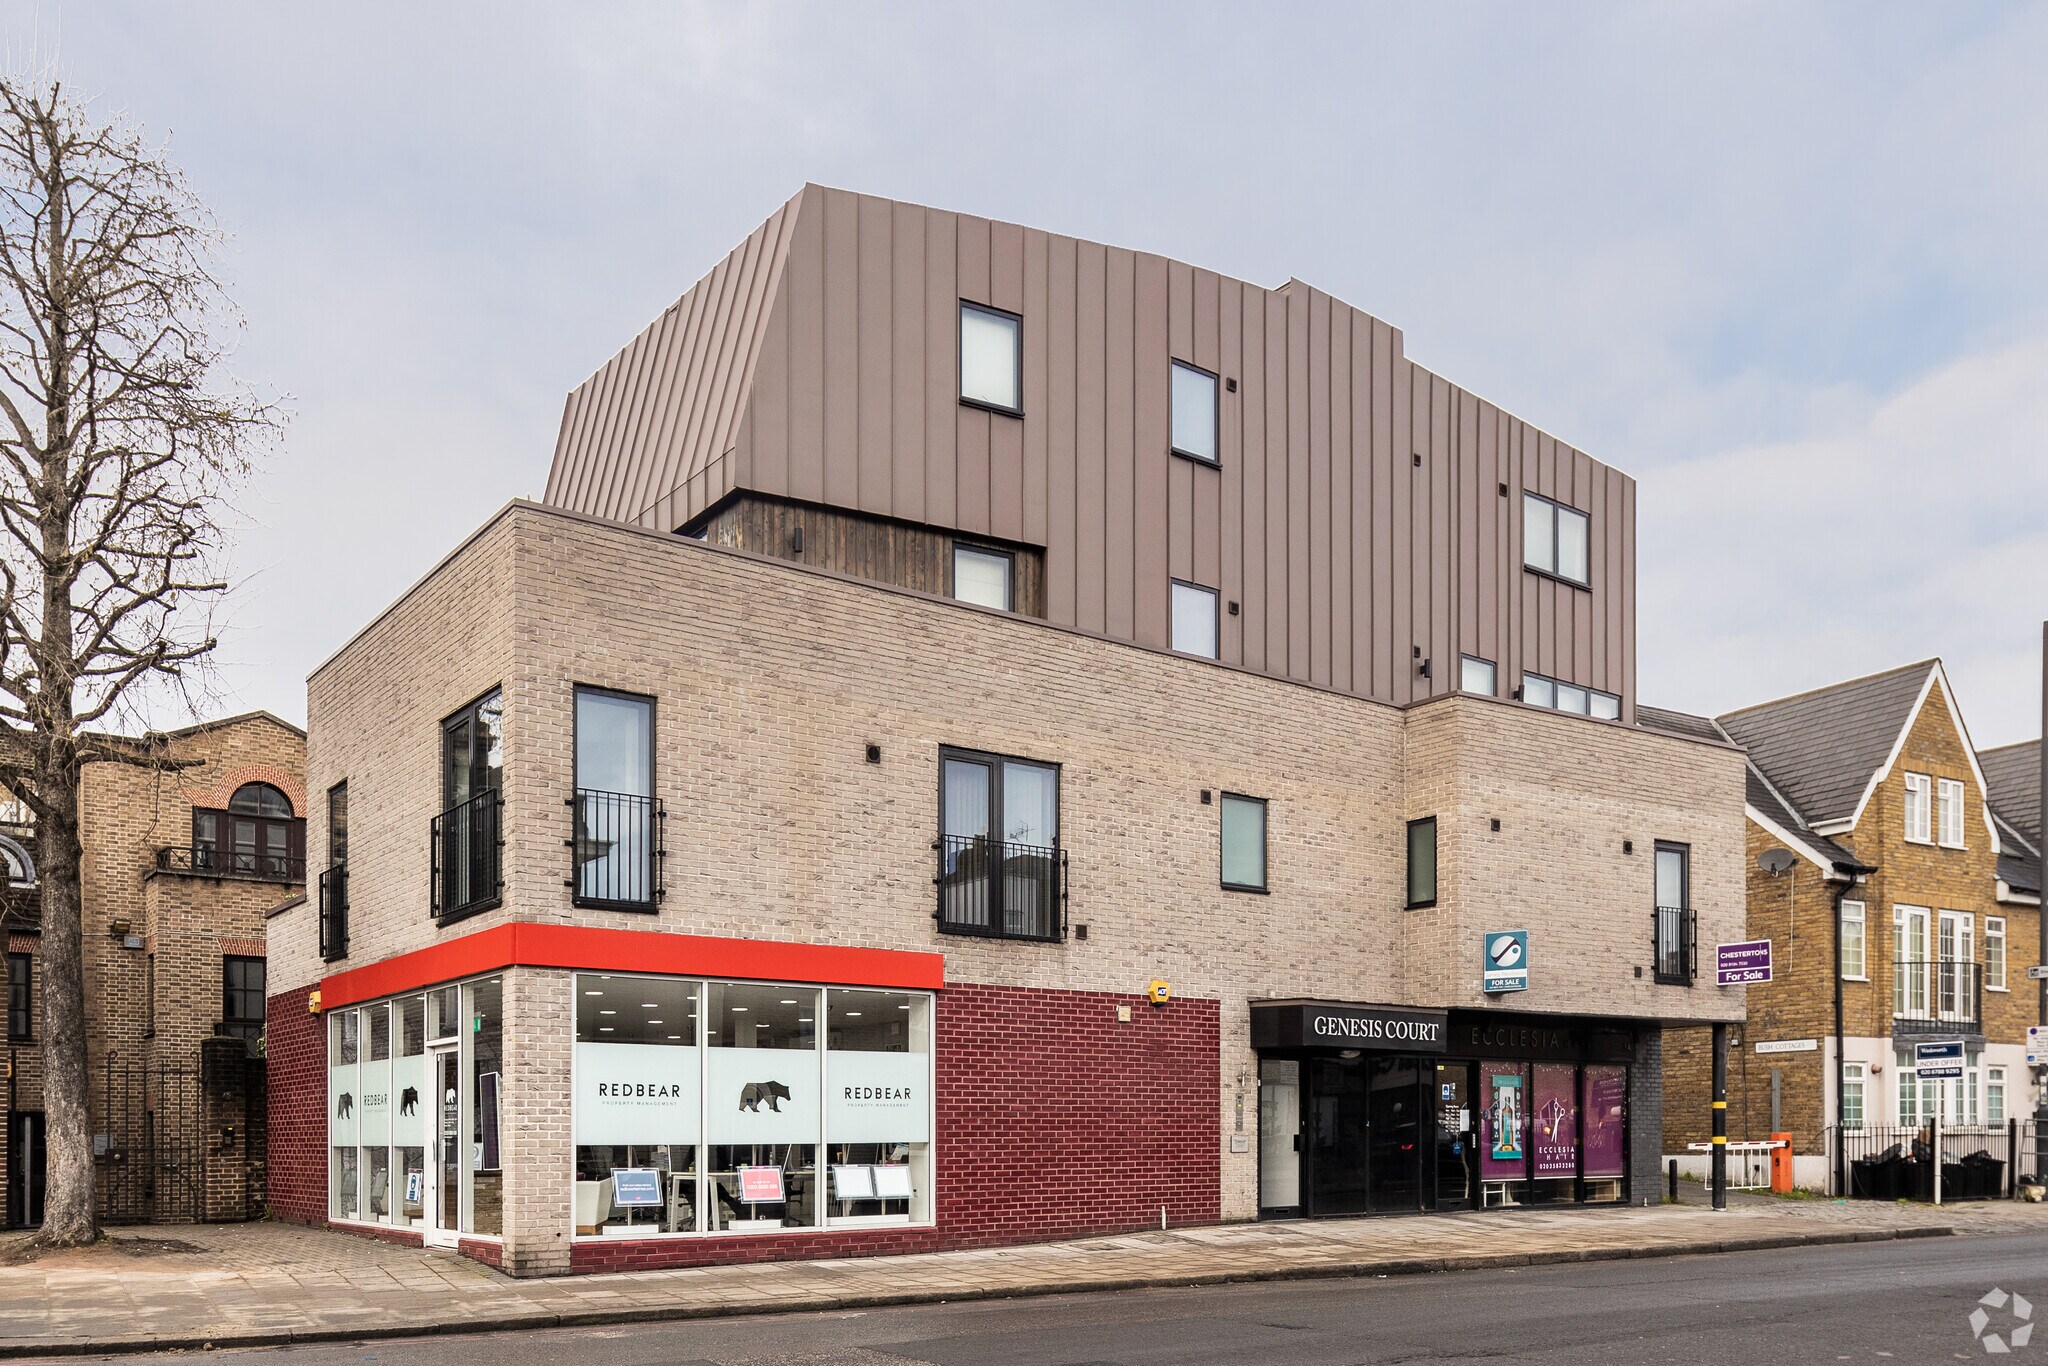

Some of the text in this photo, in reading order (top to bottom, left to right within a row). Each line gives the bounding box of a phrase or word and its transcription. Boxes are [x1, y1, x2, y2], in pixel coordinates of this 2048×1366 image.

[1720, 949, 1768, 959] CHESTERTONS
[1726, 970, 1764, 981] For Sale
[1314, 1016, 1440, 1041] GENESIS COURT
[1471, 1027, 1559, 1049] ECCLESIA
[1775, 1042, 1806, 1050] COTTAGES
[1917, 1060, 1940, 1068] UNDER
[599, 1083, 680, 1098] REDBEAR
[844, 1087, 911, 1100] REDBEAR
[364, 1093, 388, 1106] REDBEAR
[1538, 1146, 1575, 1154] ECCLESIA
